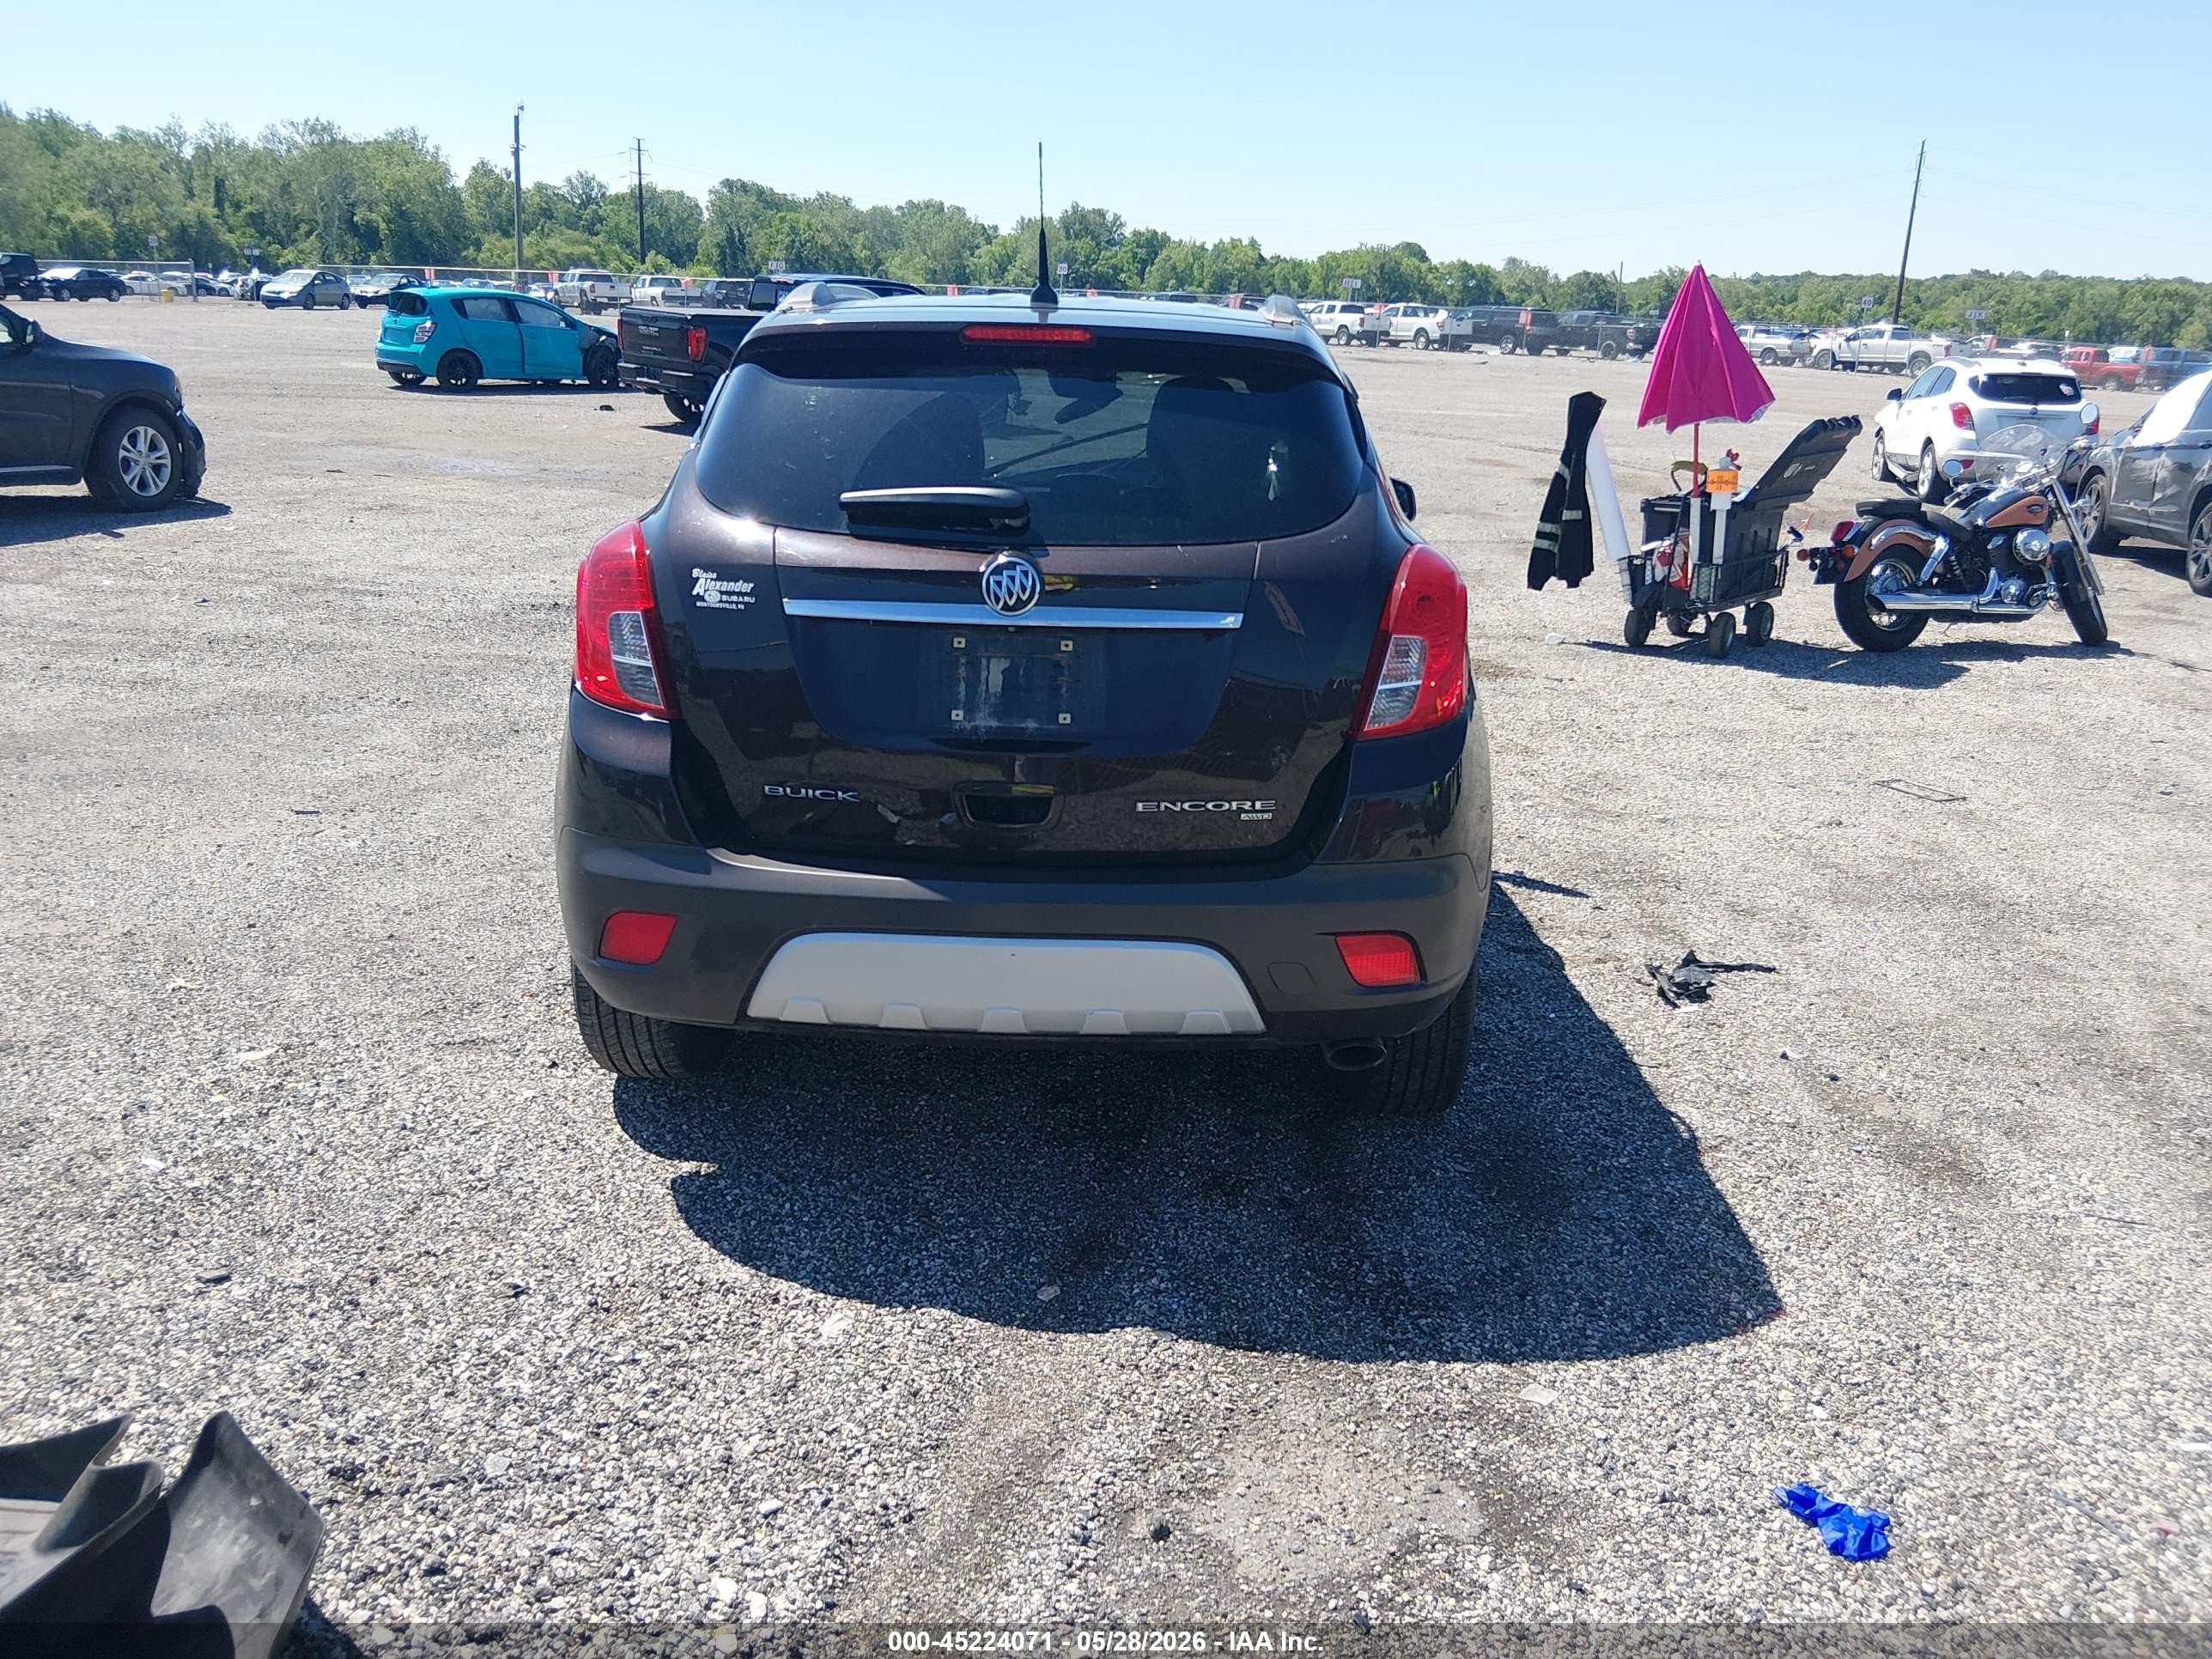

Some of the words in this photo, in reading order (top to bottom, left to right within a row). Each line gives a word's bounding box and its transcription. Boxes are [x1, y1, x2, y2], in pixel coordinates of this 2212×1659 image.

[638, 325, 659, 337] GMC
[691, 577, 755, 596] Alexander
[720, 594, 756, 603] SUBARU
[763, 784, 860, 803] BUICK
[1135, 799, 1277, 812] ENCORE
